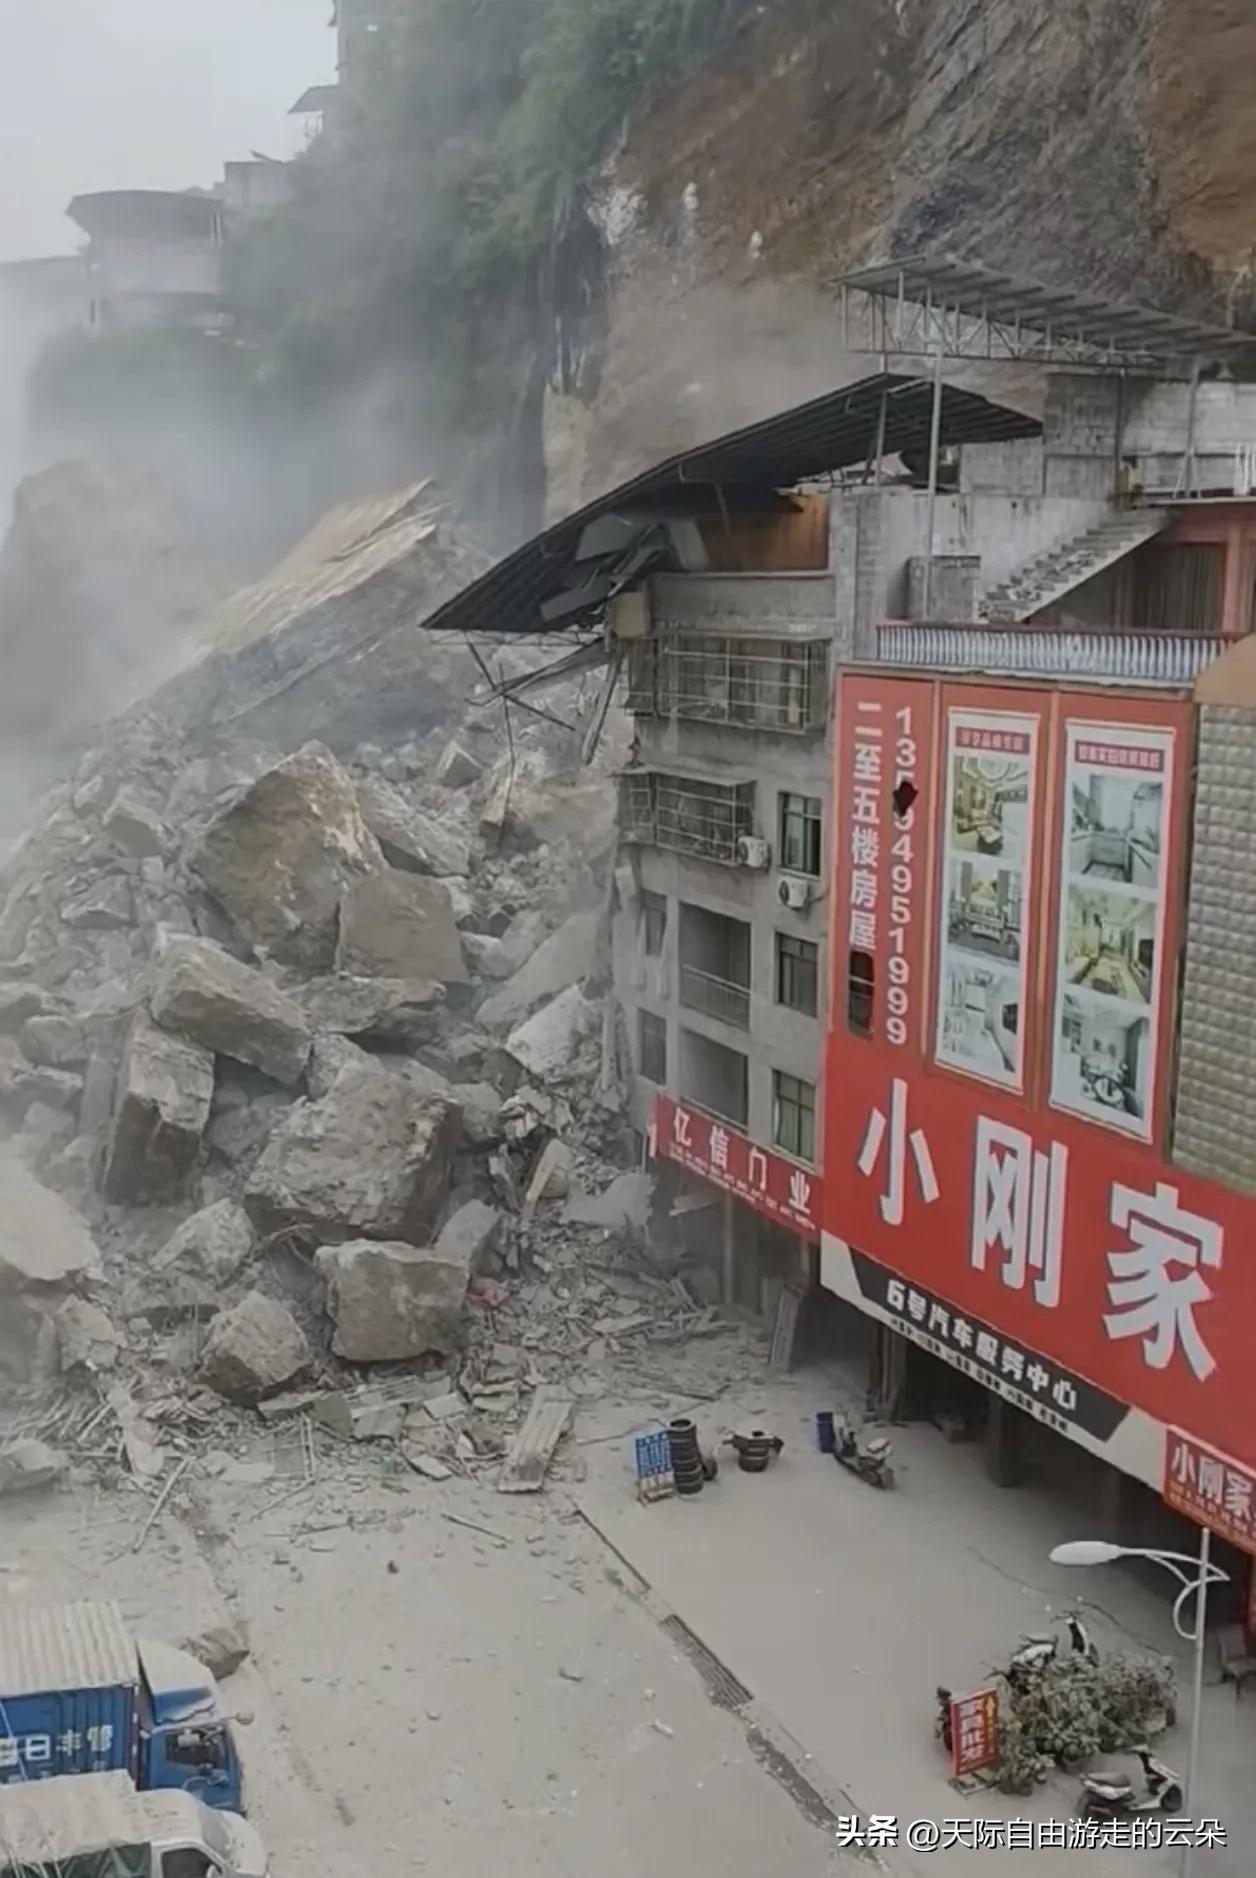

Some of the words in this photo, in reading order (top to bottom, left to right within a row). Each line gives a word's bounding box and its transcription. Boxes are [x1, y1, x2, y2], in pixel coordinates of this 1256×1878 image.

[849, 701, 883, 950] 二至五楼房屋
[673, 1106, 811, 1216] 亿信门业
[857, 1077, 1225, 1383] 小刚家
[887, 1279, 1077, 1411] 6号汽车服务中心
